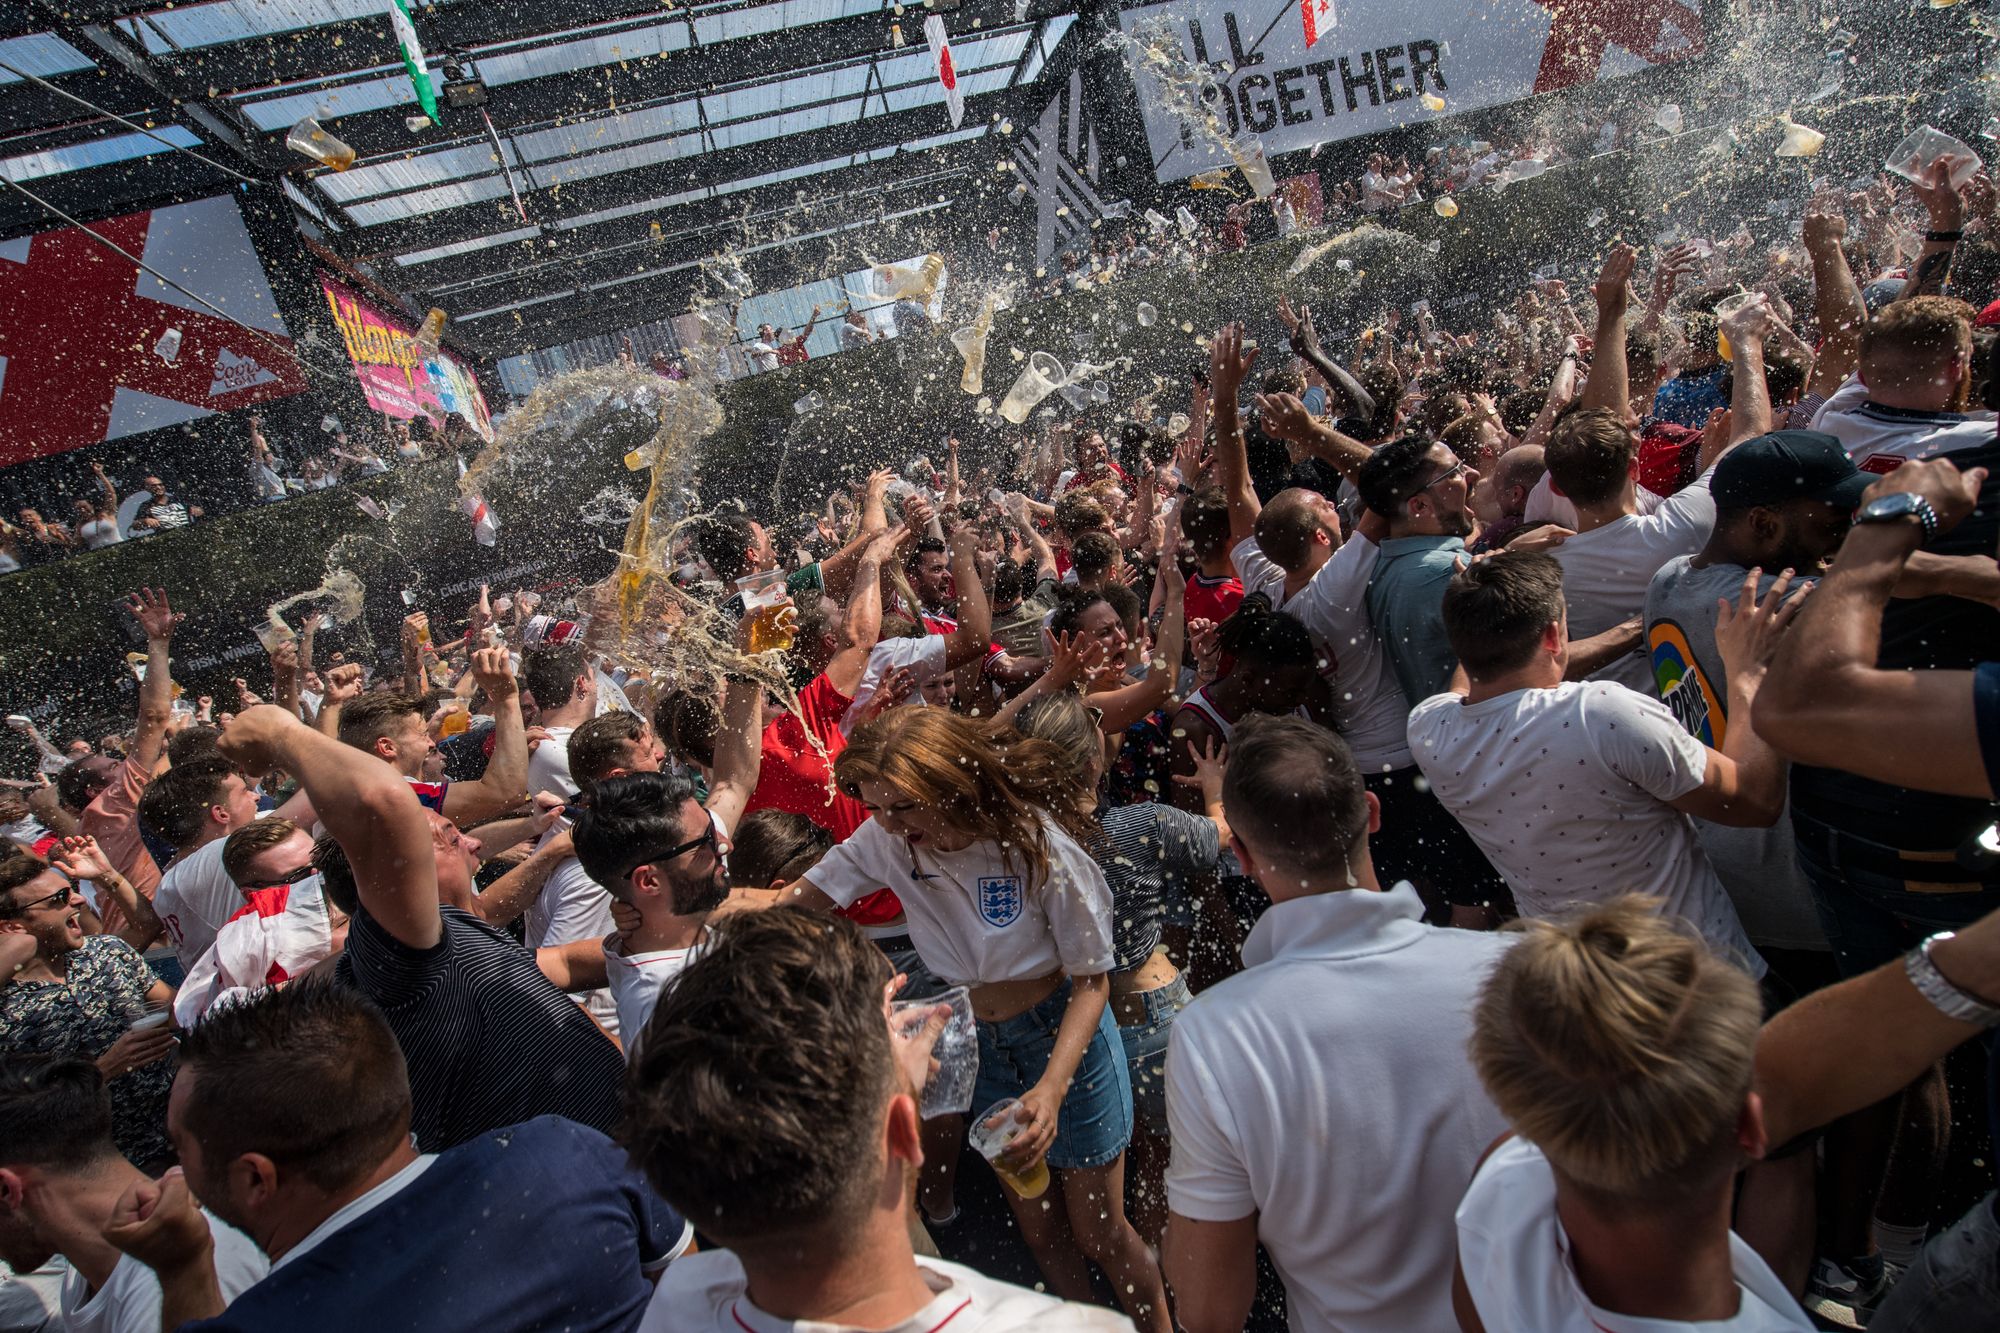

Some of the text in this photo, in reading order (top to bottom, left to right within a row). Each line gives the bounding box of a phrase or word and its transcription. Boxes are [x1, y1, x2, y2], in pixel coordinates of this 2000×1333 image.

[1174, 38, 1449, 150] OGETHER
[224, 373, 258, 388] LIGHT
[440, 576, 491, 598] CHICAGO
[222, 642, 264, 662] WINGS
